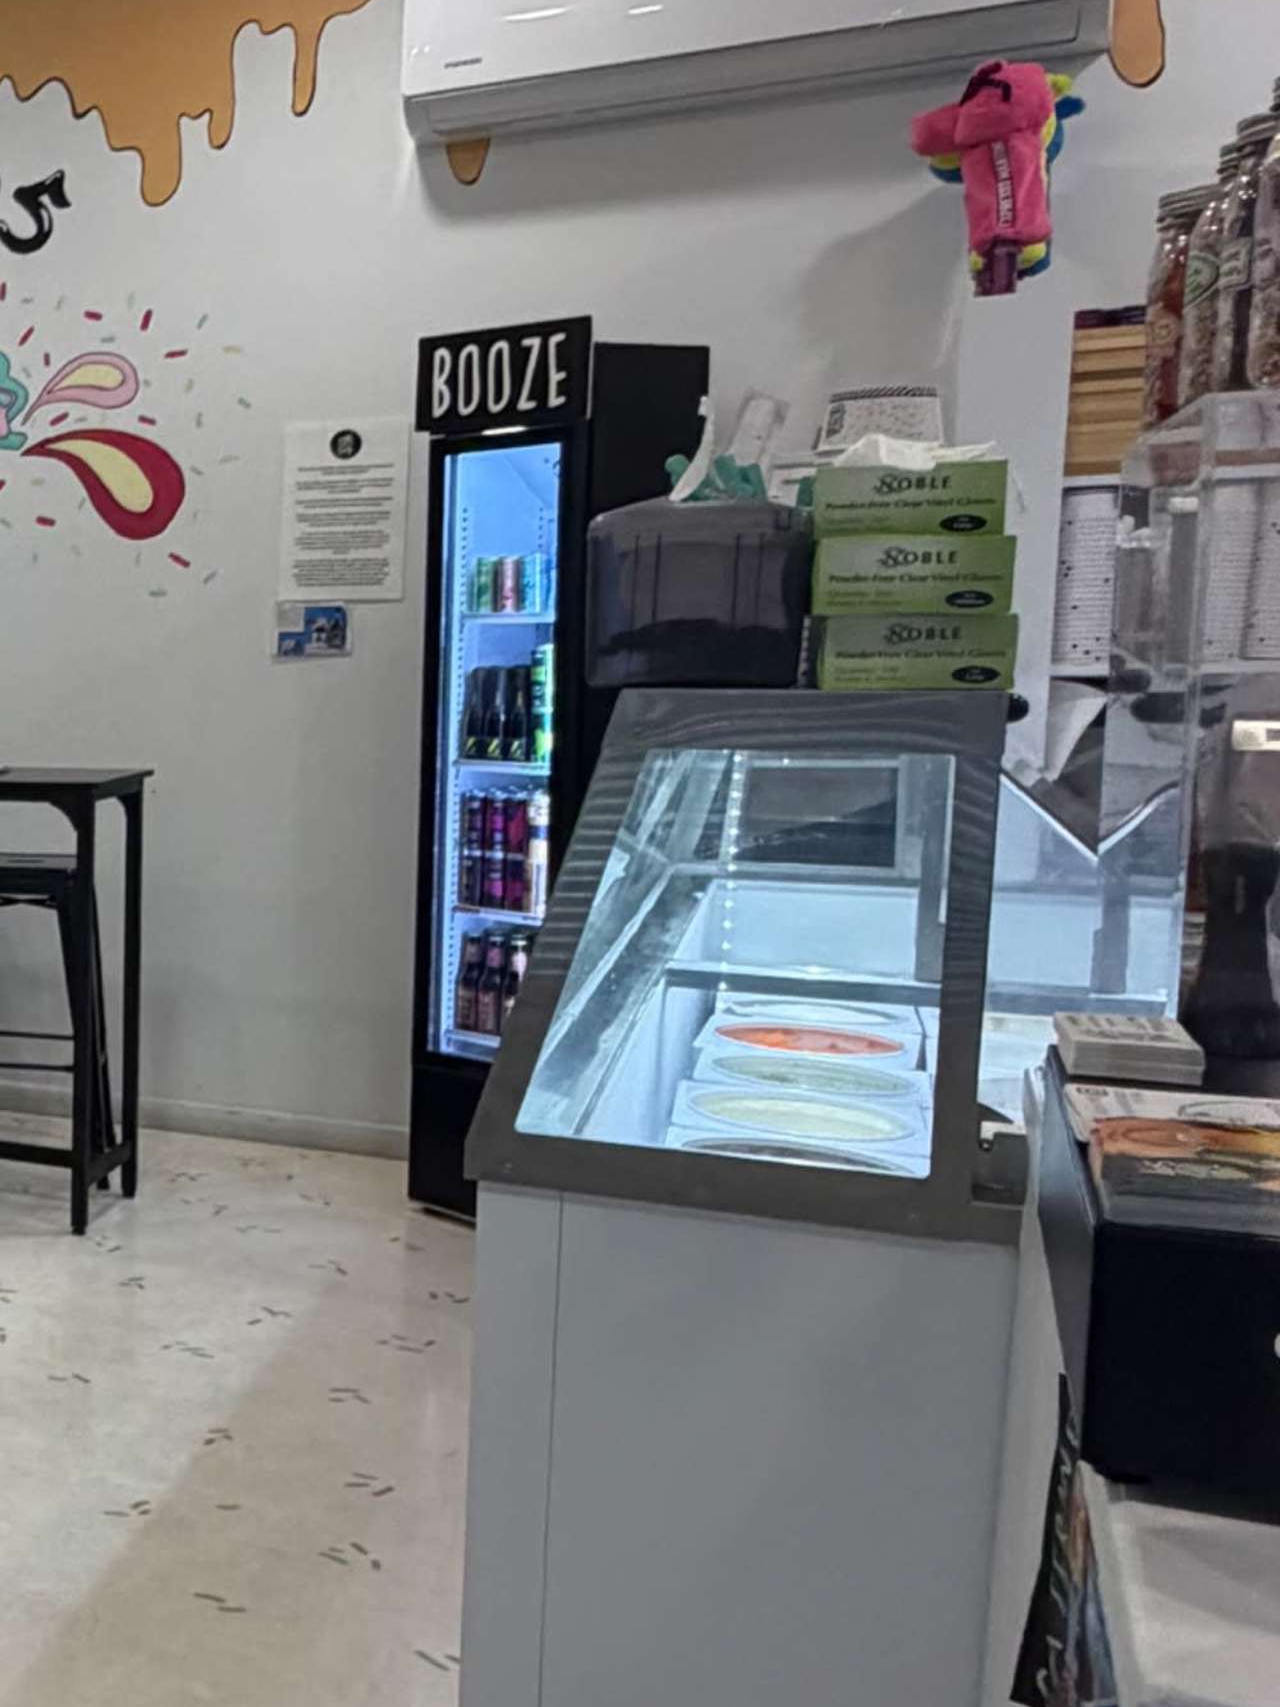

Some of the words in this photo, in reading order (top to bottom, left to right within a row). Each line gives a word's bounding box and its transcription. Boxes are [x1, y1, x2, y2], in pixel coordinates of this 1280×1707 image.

[431, 331, 568, 419] BOOZE
[873, 473, 952, 496] NOBLE
[878, 546, 960, 568] NOBLE
[883, 622, 962, 646] NOBLE
